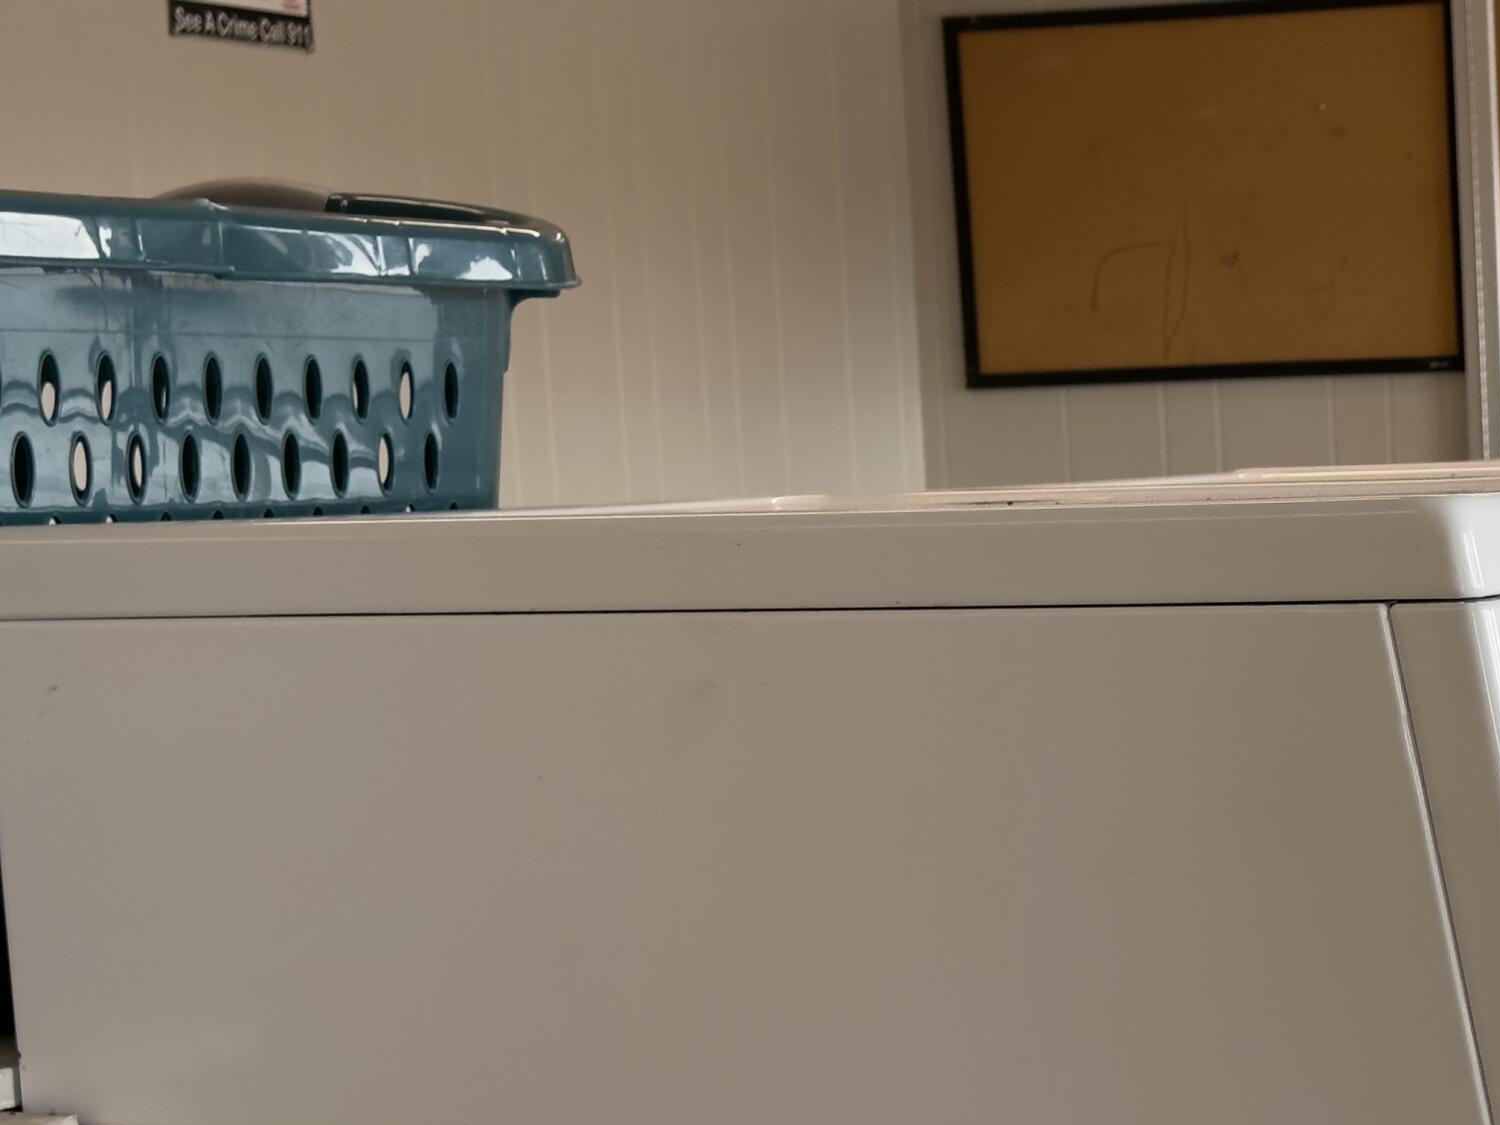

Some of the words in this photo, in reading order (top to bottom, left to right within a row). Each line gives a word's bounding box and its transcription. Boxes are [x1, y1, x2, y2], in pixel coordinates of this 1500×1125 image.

[175, 6, 202, 33] See
[205, 11, 216, 31] A
[217, 12, 258, 40] Crime
[261, 17, 286, 44] Call
